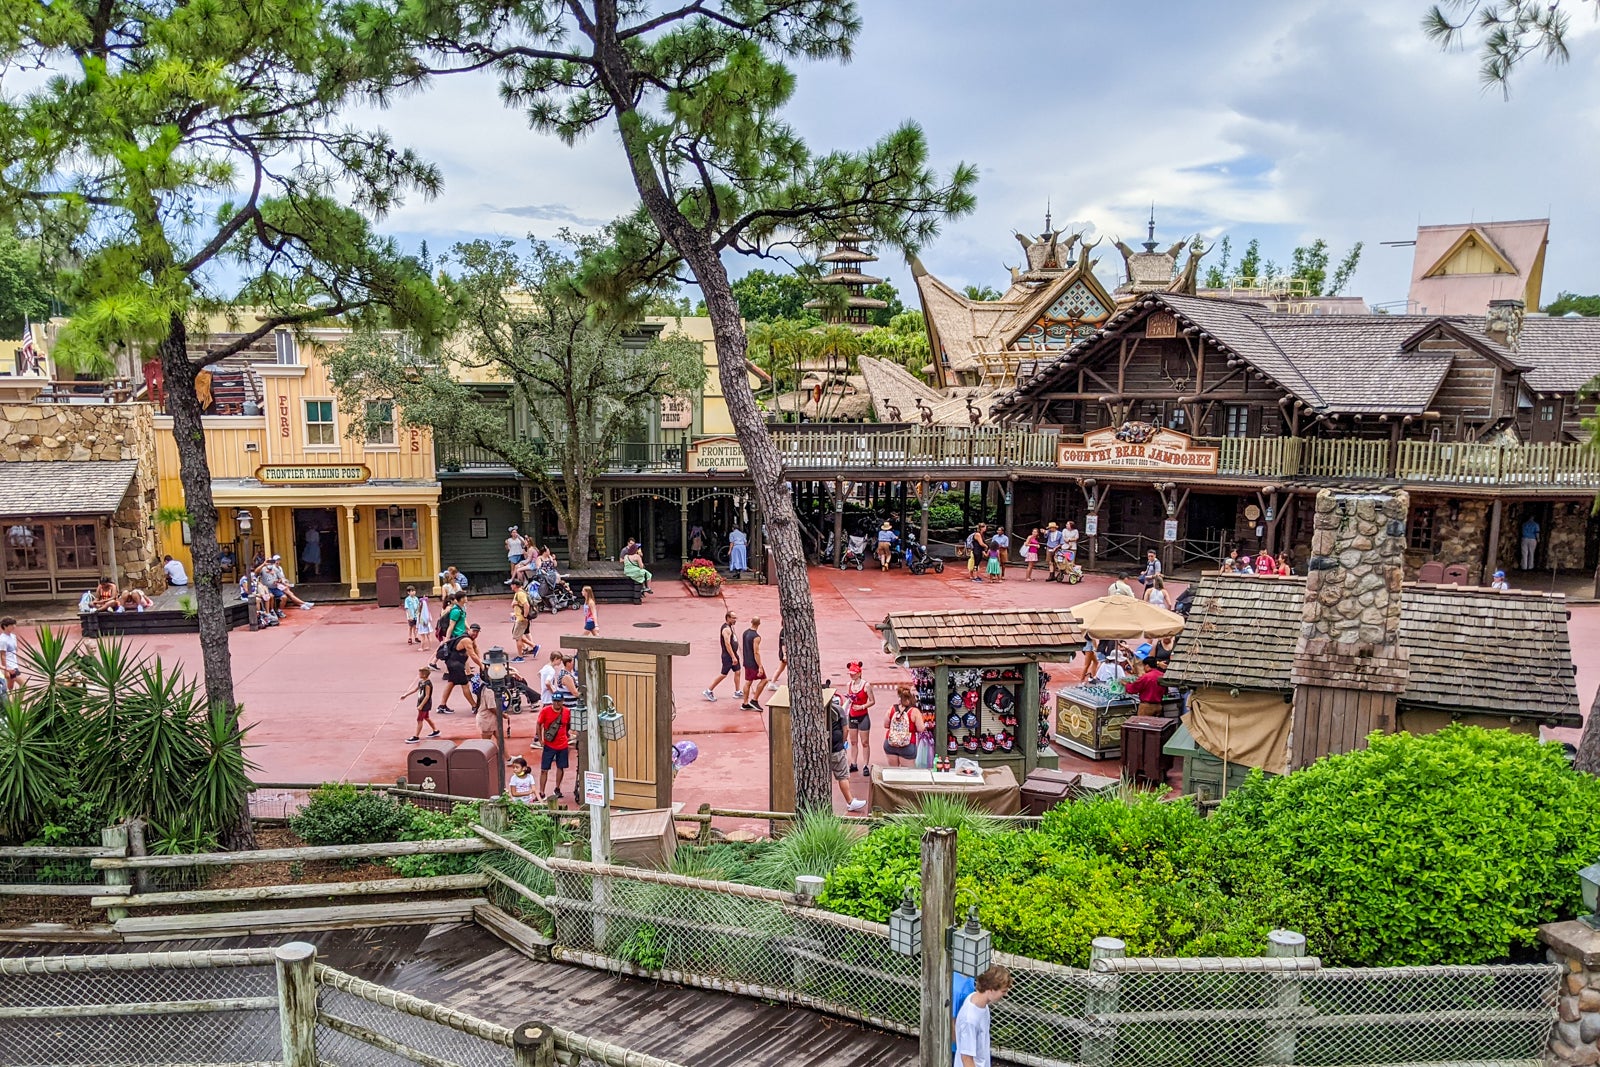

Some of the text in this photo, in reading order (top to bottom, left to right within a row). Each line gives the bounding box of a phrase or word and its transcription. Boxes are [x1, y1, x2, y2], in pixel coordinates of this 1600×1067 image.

[1149, 327, 1173, 335] HALL
[279, 396, 289, 437] FURS
[702, 446, 744, 456] FRONTIER
[1063, 445, 1211, 466] COUNTRY BEAR JAMBOREE
[266, 468, 361, 479] FRONTIER TRADING POST
